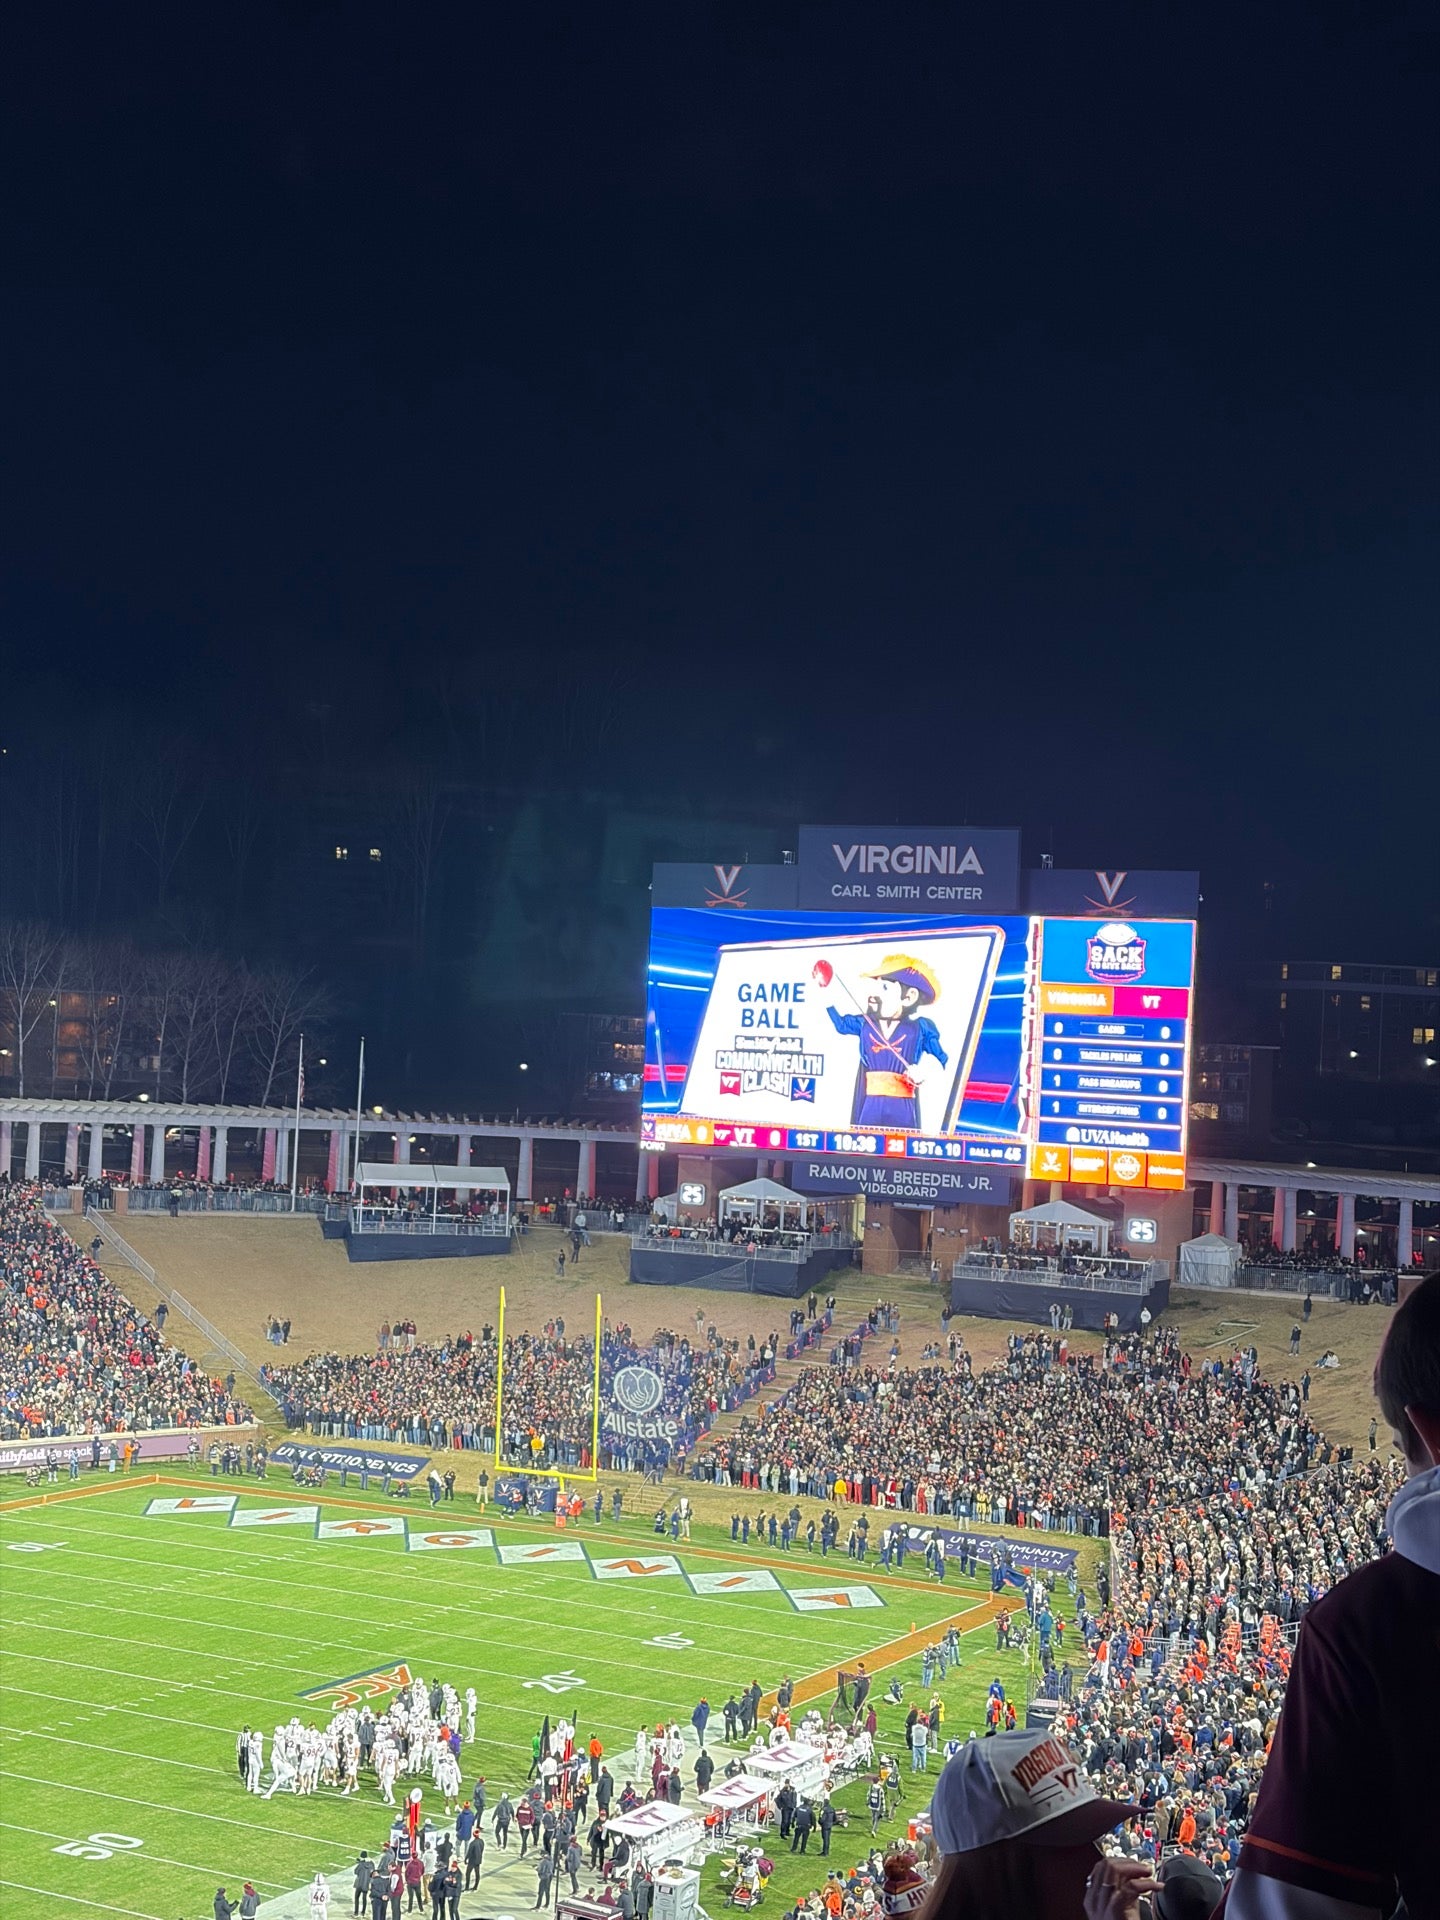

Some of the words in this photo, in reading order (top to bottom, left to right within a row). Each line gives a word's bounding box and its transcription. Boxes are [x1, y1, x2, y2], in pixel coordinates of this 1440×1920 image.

[832, 845, 984, 875] VIRGINIA
[831, 884, 870, 897] CARL
[876, 886, 920, 898] SMITH
[926, 886, 983, 900] CENTER
[1091, 945, 1143, 963] SACK
[738, 983, 805, 1002] GAME
[1142, 995, 1161, 1009] VT
[741, 1008, 799, 1029] BALL
[1161, 1026, 1171, 1039] 0
[717, 1051, 823, 1075] COMMONWEALTH
[1160, 1053, 1169, 1066] 0
[744, 1071, 789, 1096] CLASH
[1054, 1074, 1061, 1087] 1
[1079, 1077, 1099, 1088] PASS
[1159, 1080, 1168, 1093] 0
[1052, 1101, 1060, 1113] 1
[1158, 1107, 1167, 1120] 0
[734, 1128, 756, 1144] VT
[796, 1133, 819, 1147] 1ST
[912, 1141, 934, 1156] 1ST
[945, 1142, 961, 1157] 10
[809, 1164, 867, 1182] RAMON
[872, 1168, 887, 1183] W.
[968, 1178, 993, 1191] JR.
[859, 1181, 938, 1198] VIDEOBOARD
[1130, 1221, 1153, 1240] 25
[602, 1412, 678, 1438] Allstate
[980, 1540, 1069, 1559] CMUNITY
[1011, 1552, 1061, 1565] UNION
[640, 1635, 695, 1650] 10
[303, 1663, 414, 1711] ACC
[522, 1674, 587, 1694] 20
[758, 1746, 801, 1763] VT
[711, 1780, 756, 1798] VT
[1054, 1767, 1078, 1796] VT
[619, 1806, 668, 1827] VT
[50, 1832, 144, 1860] 50
[313, 1891, 325, 1903] 46
